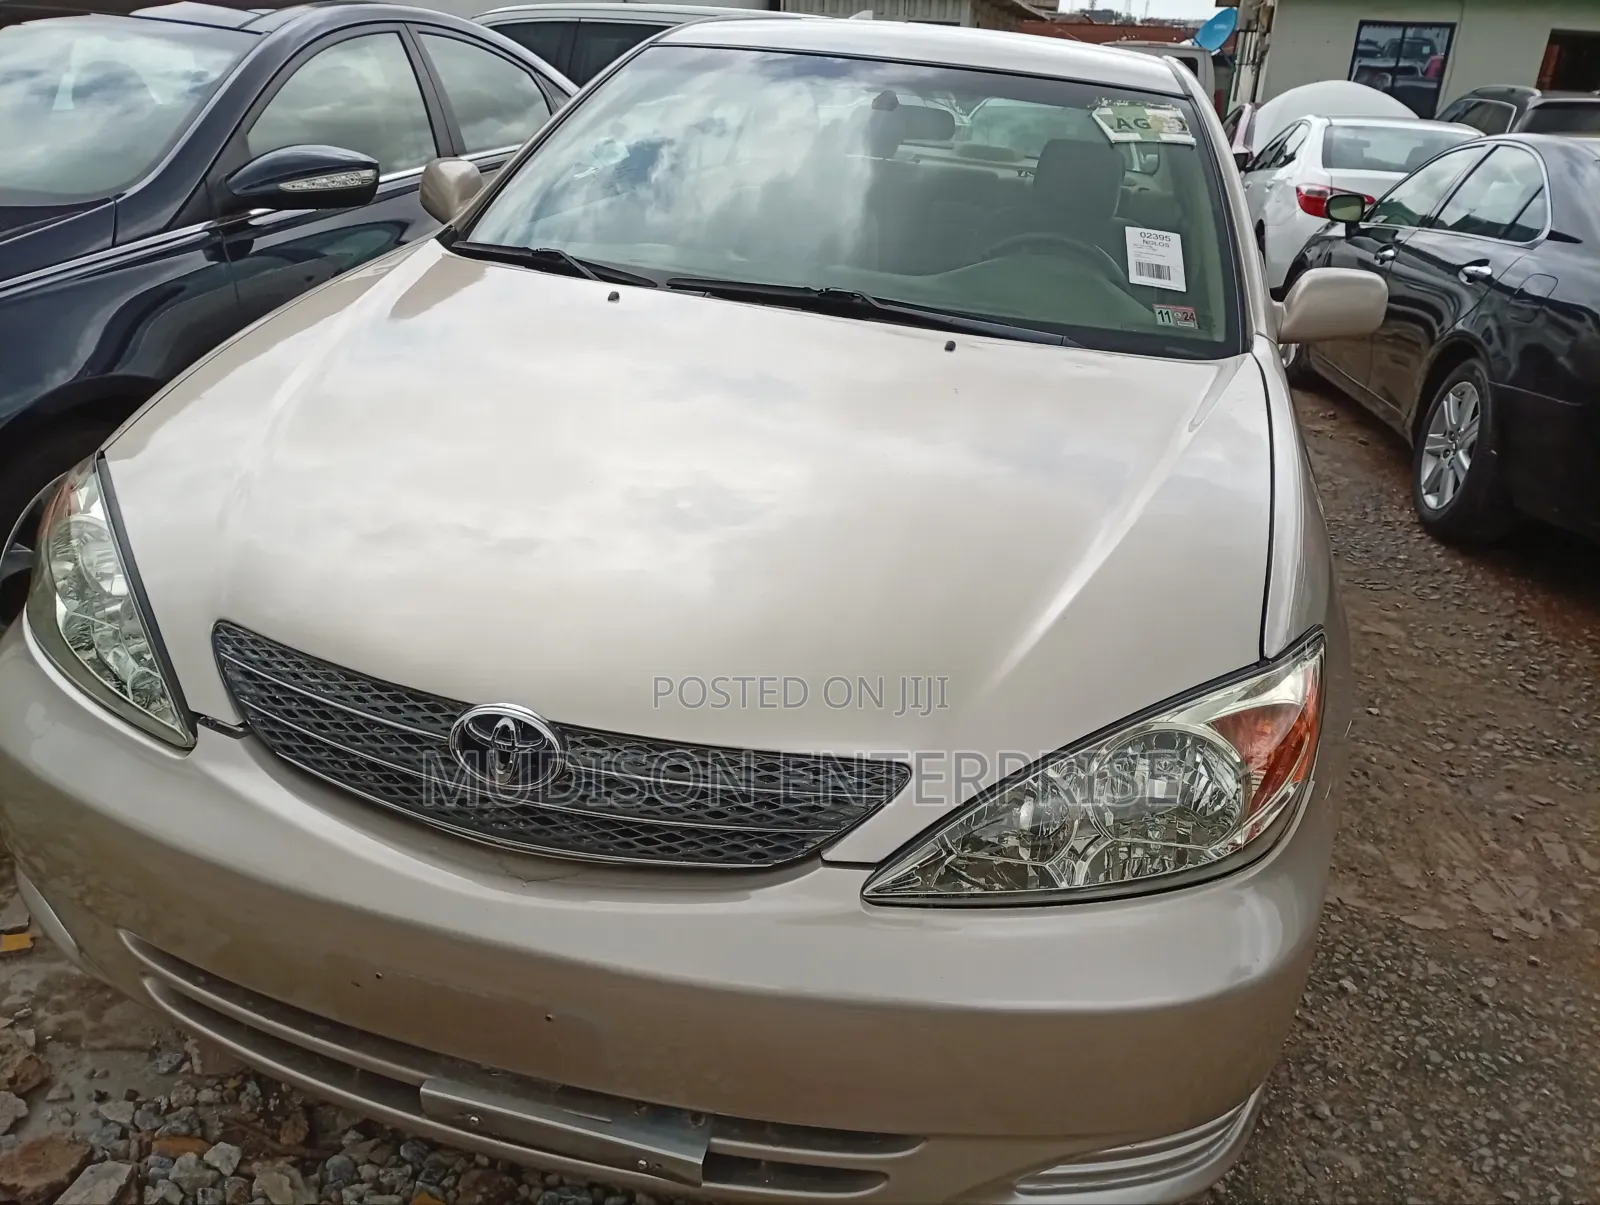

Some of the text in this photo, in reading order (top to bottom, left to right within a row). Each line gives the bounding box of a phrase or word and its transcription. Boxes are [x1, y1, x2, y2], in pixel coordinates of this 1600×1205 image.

[1139, 231, 1171, 242] 02395
[1157, 309, 1195, 323] 11 24
